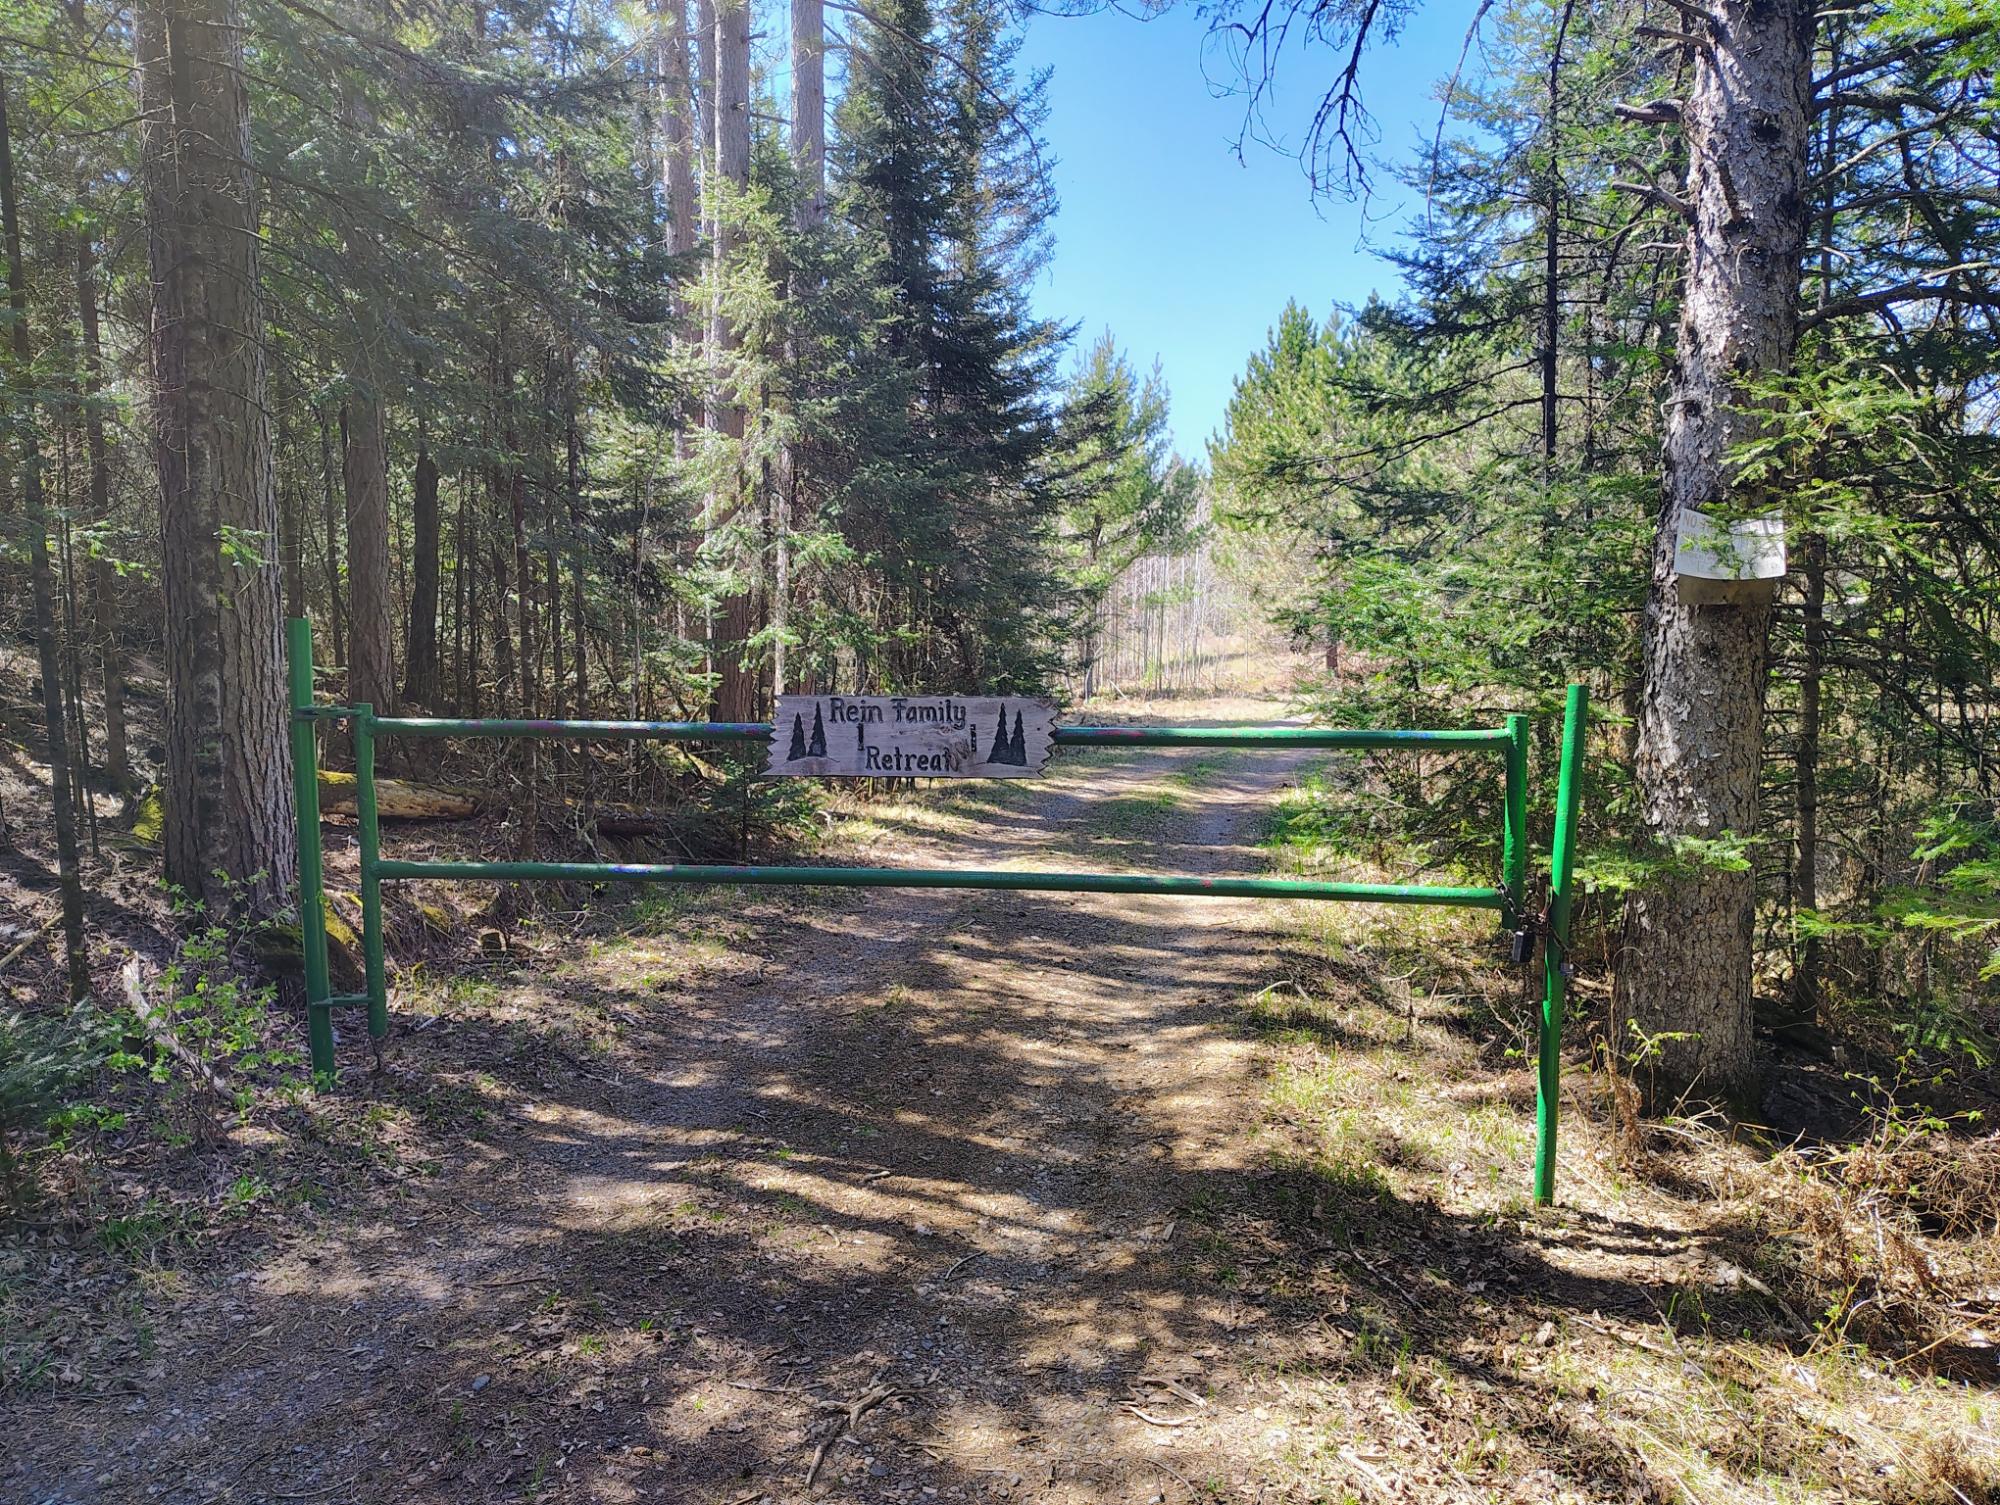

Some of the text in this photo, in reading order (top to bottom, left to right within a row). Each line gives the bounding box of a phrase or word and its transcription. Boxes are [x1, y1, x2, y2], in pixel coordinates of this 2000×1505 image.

[1682, 511, 1698, 529] NO
[829, 697, 966, 730] Rein Family
[865, 746, 951, 772] Retreat
